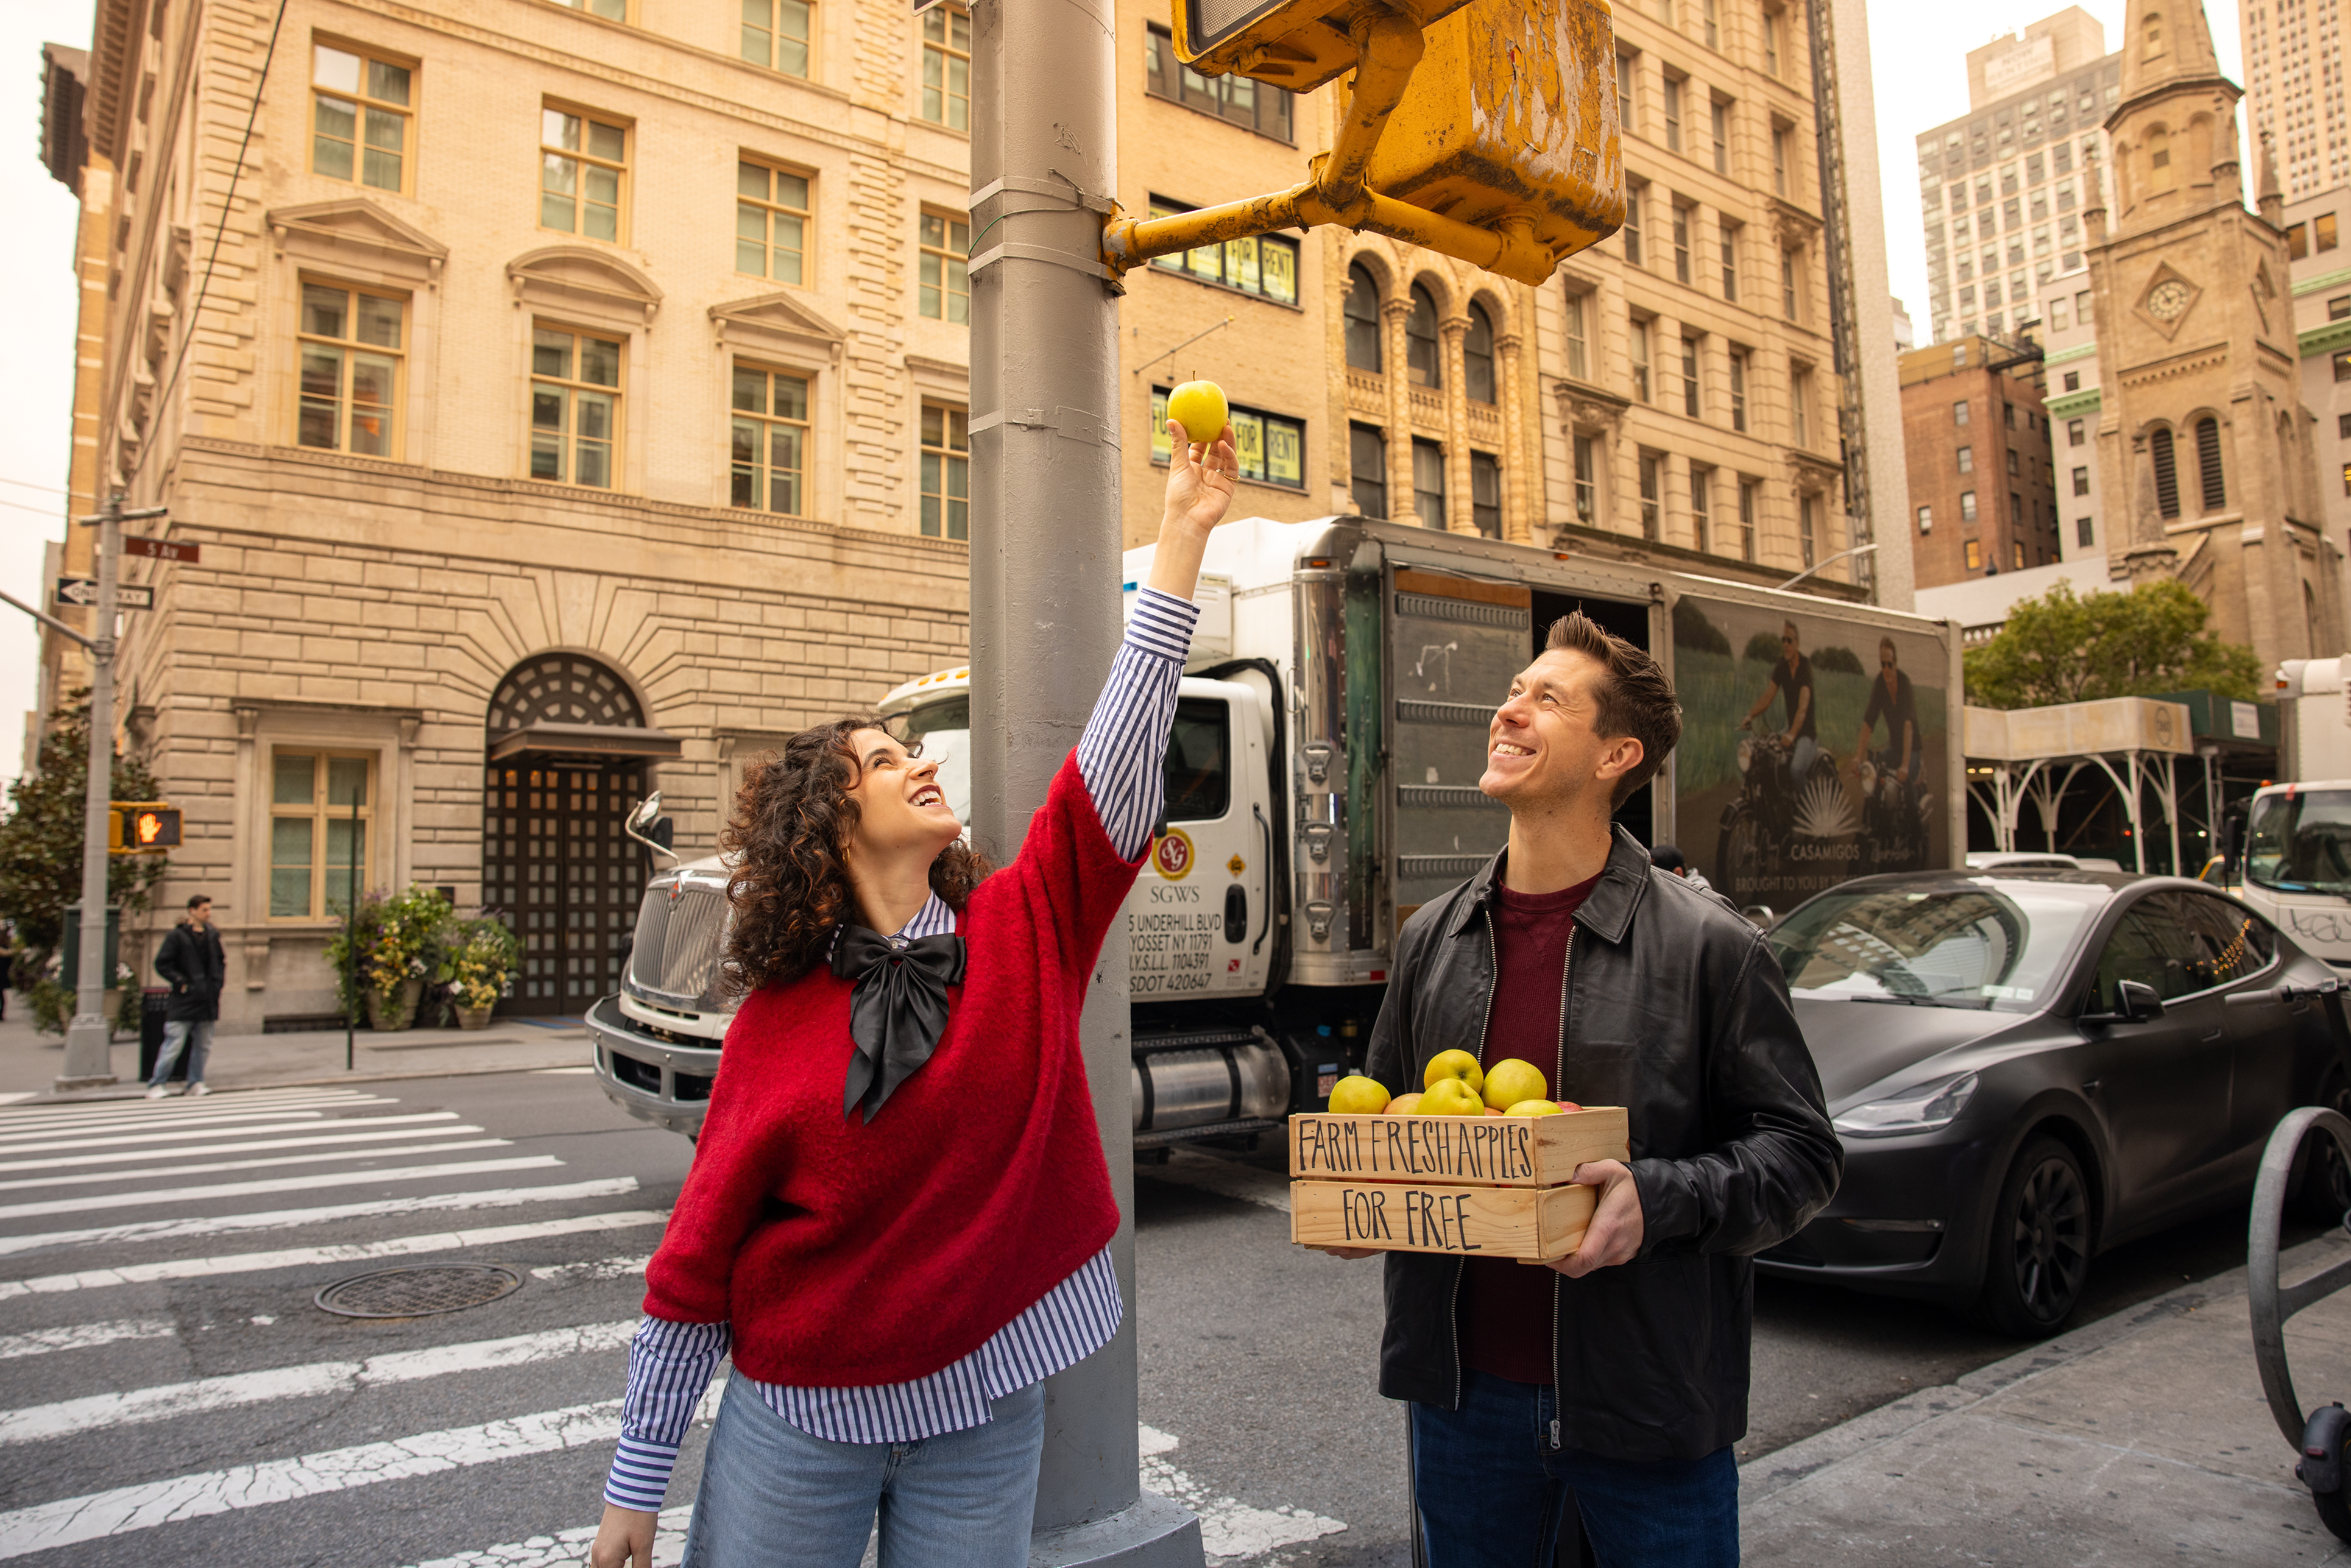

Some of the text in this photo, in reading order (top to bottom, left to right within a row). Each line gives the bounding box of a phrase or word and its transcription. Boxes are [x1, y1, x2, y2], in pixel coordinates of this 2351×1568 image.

[1231, 236, 1253, 267] FOR
[1263, 247, 1291, 281] RENT
[1236, 422, 1257, 454] FOR
[1269, 428, 1296, 462] RENT
[147, 542, 157, 557] 5
[1161, 838, 1185, 871] SG
[1791, 843, 1859, 861] CASAMIGOS
[1735, 876, 1781, 892] BROUGHT
[1783, 876, 1796, 891] TO
[1798, 875, 1818, 891] YOU
[1819, 875, 1830, 890] BY
[1150, 885, 1200, 903] SGWS
[1137, 914, 1194, 932] UNDERHILL
[1197, 914, 1222, 931] BLVD
[1129, 933, 1212, 952] YOSSET NY 11791
[1172, 953, 1209, 970] 1104391
[1130, 975, 1165, 993] SDOT
[1167, 973, 1212, 991] 420647
[1299, 1119, 1532, 1181] FARM FRESH APPLES
[1343, 1189, 1482, 1251] FOR FREE
